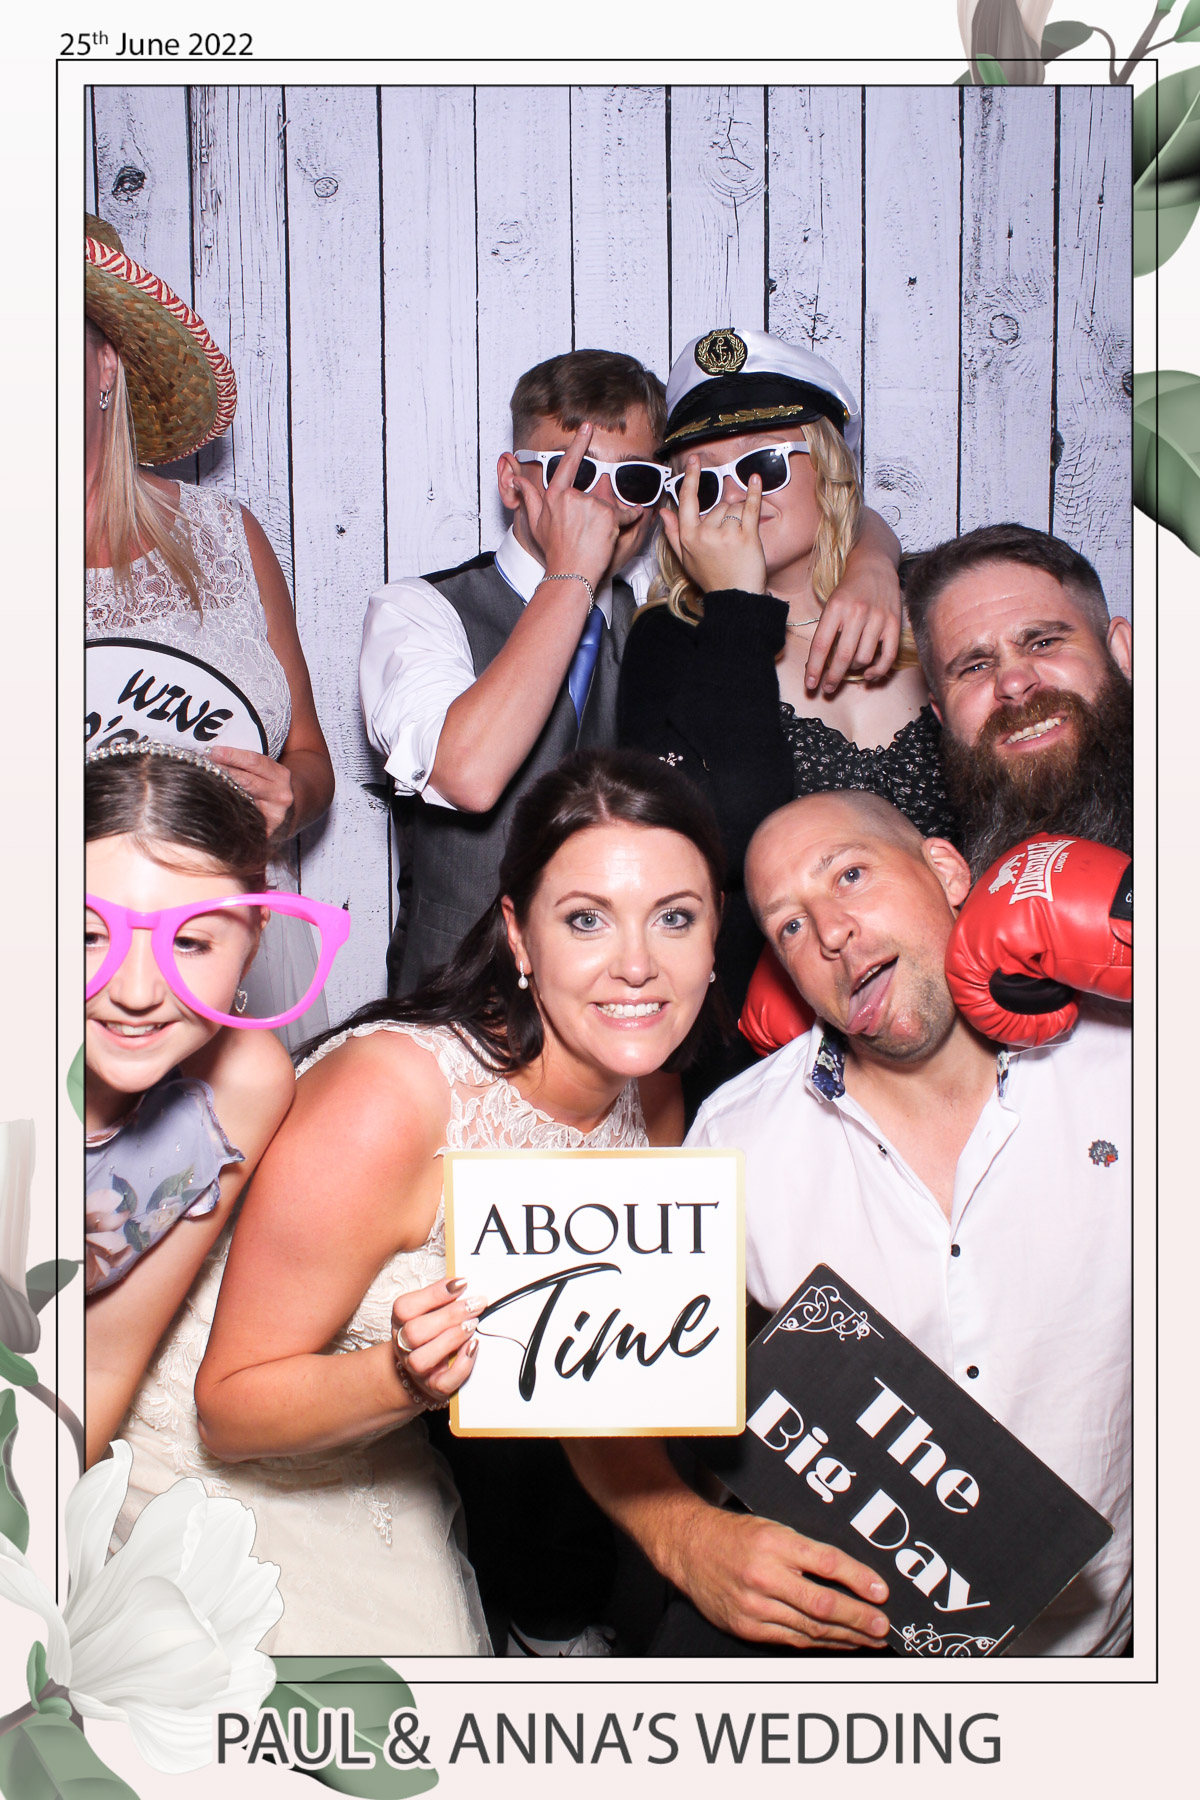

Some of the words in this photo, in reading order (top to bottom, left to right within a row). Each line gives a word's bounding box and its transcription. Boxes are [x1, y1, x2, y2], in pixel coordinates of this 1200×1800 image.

[117, 668, 234, 742] WINE
[1008, 839, 1077, 905] LONSDALE
[1053, 851, 1070, 873] LONDON
[470, 1200, 720, 1256] ABOUT
[475, 1262, 720, 1402] Time
[855, 1376, 980, 1514] The
[746, 1389, 857, 1503] Big
[849, 1488, 991, 1612] Day
